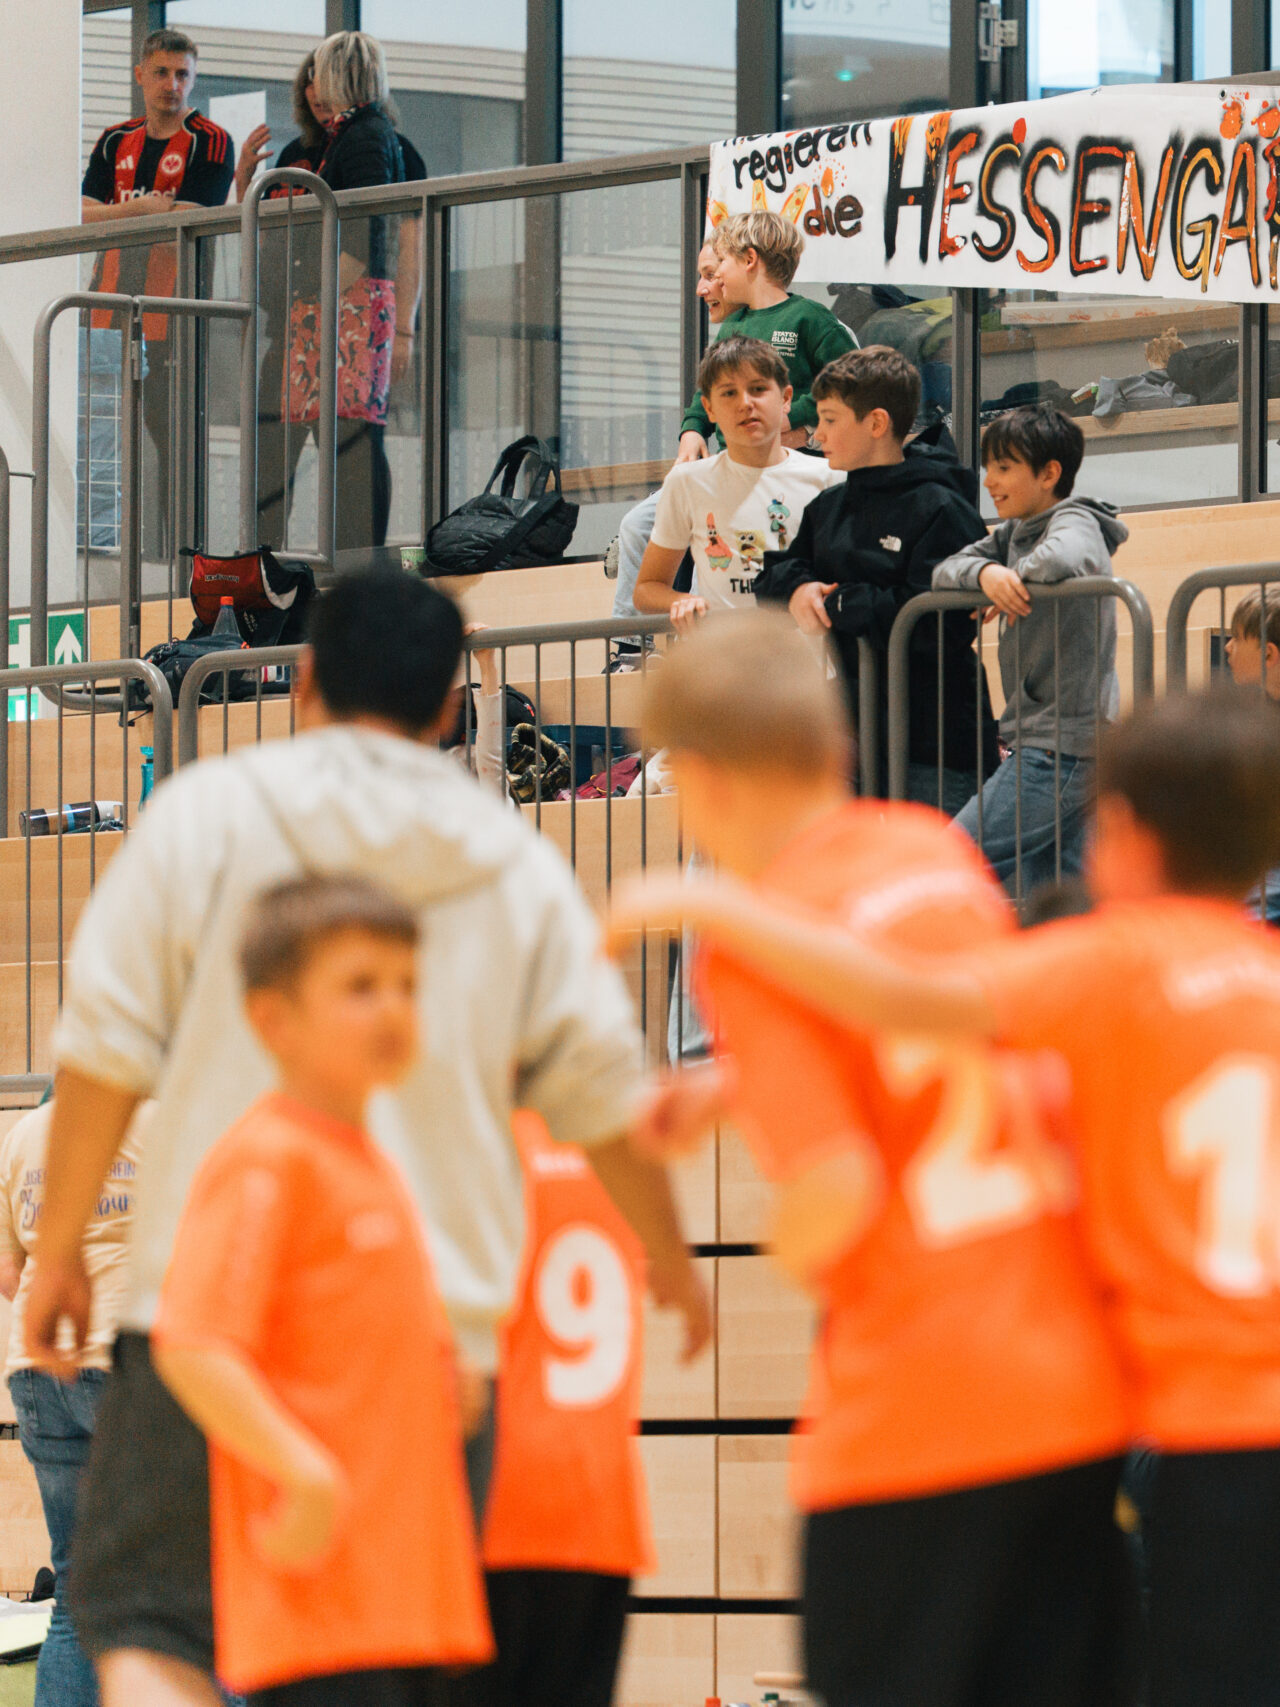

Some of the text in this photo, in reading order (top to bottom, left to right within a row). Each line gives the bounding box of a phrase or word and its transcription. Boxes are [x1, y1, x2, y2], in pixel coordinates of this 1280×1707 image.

[733, 122, 872, 193] regieren
[804, 184, 864, 238] die
[771, 336, 795, 344] ISLAND
[772, 330, 799, 338] STATEN
[538, 1224, 632, 1408] 9
